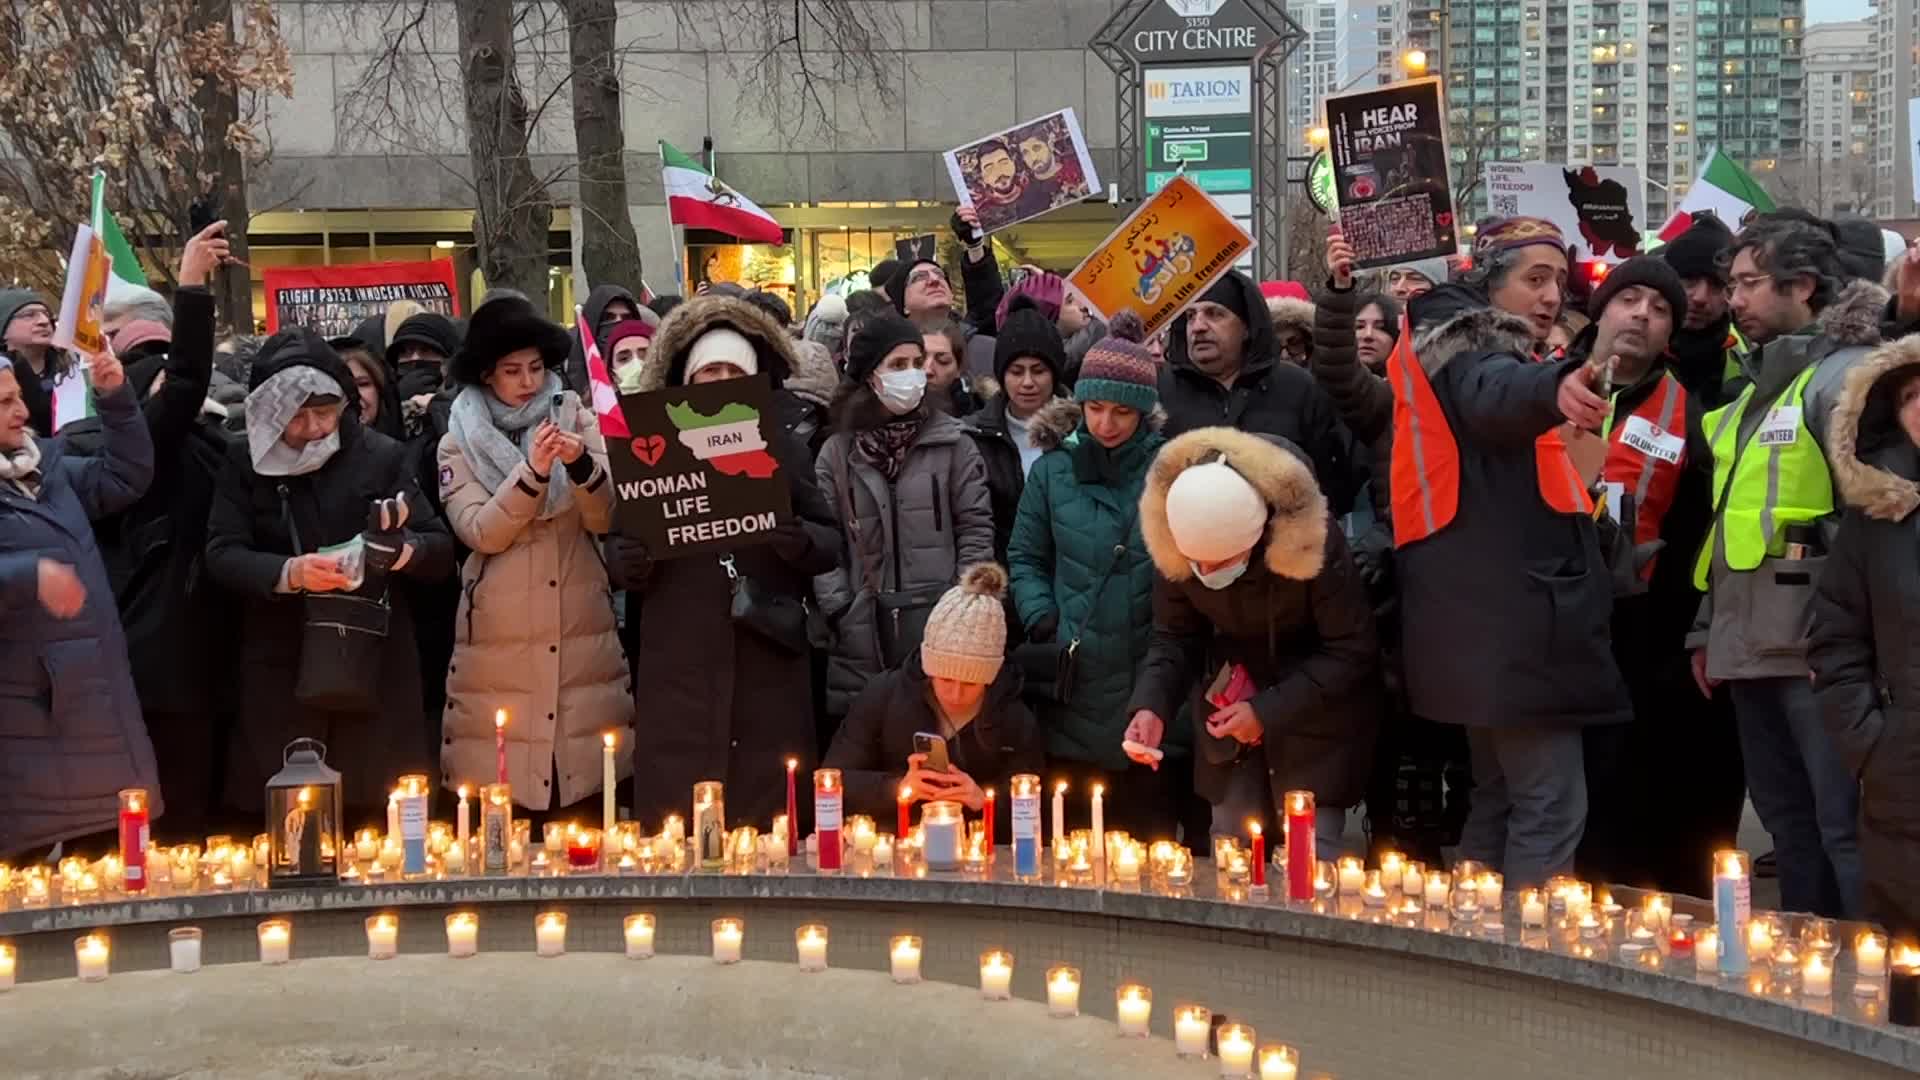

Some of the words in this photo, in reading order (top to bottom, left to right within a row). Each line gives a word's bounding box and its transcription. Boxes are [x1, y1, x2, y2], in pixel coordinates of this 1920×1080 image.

[1134, 30, 1178, 52] CITY
[1182, 27, 1256, 50] CENTRE
[1169, 80, 1240, 98] TARION
[1362, 103, 1418, 129] HEAR
[1354, 132, 1402, 152] IRAN
[1491, 183, 1534, 192] FREEDOM
[279, 289, 315, 305] FLIGHT
[319, 288, 353, 303] PS752
[355, 284, 407, 302] INNOCENT
[410, 283, 449, 299] VICTIMS
[707, 432, 743, 448] IRAN
[1623, 430, 1678, 463] VOLUNTEER
[617, 471, 708, 500] WOMAN
[662, 495, 712, 519] LIFE
[667, 512, 777, 546] FREEDOM
